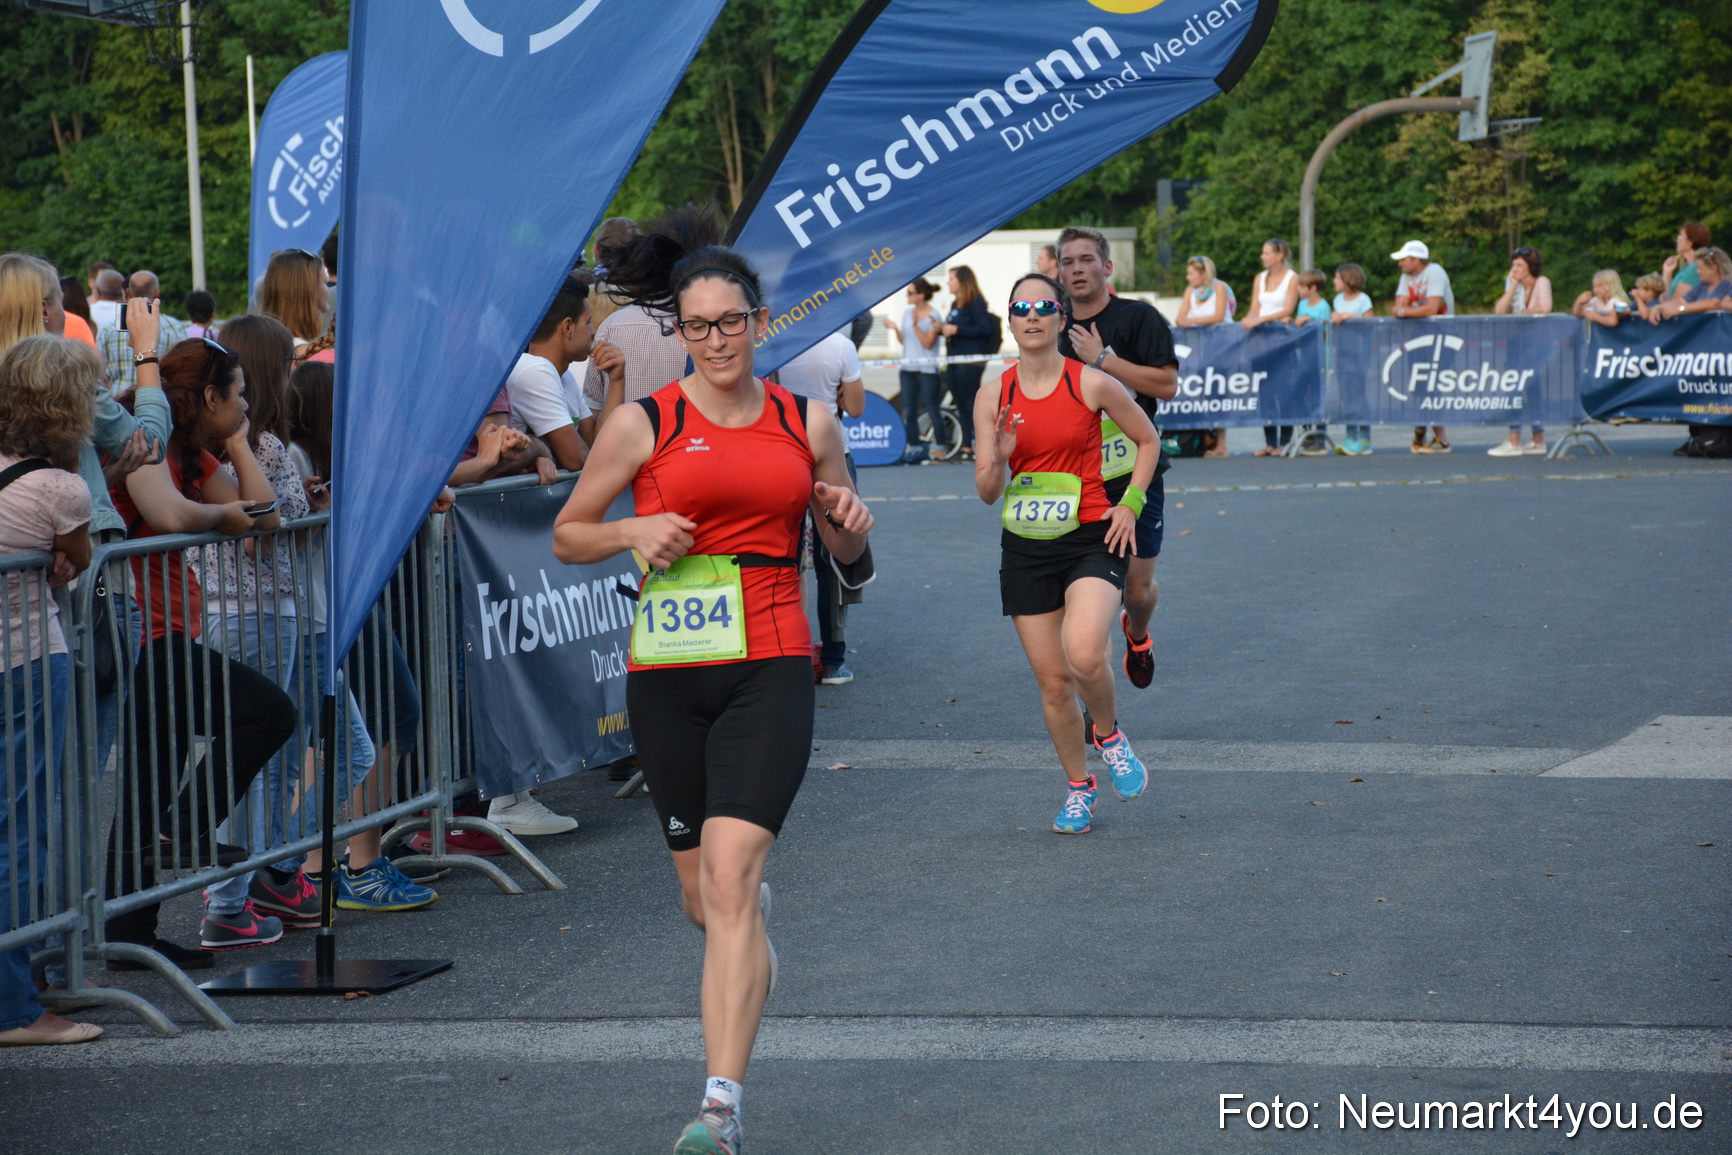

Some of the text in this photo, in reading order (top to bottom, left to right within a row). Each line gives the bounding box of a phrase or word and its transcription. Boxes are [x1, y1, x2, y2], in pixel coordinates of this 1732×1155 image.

[1000, 0, 1242, 152] Druck und Medien
[775, 26, 1121, 248] Frischmann
[1408, 362, 1534, 393] Fischer
[1678, 378, 1718, 394] Druck
[1157, 397, 1258, 415] UTOMOBILE
[1420, 397, 1523, 410] AUTOMOBILE
[685, 445, 710, 453] erima
[1012, 500, 1071, 522] 1379
[641, 594, 733, 634] 1384
[658, 638, 713, 649] Bianka Mederer
[590, 641, 628, 683] Druck
